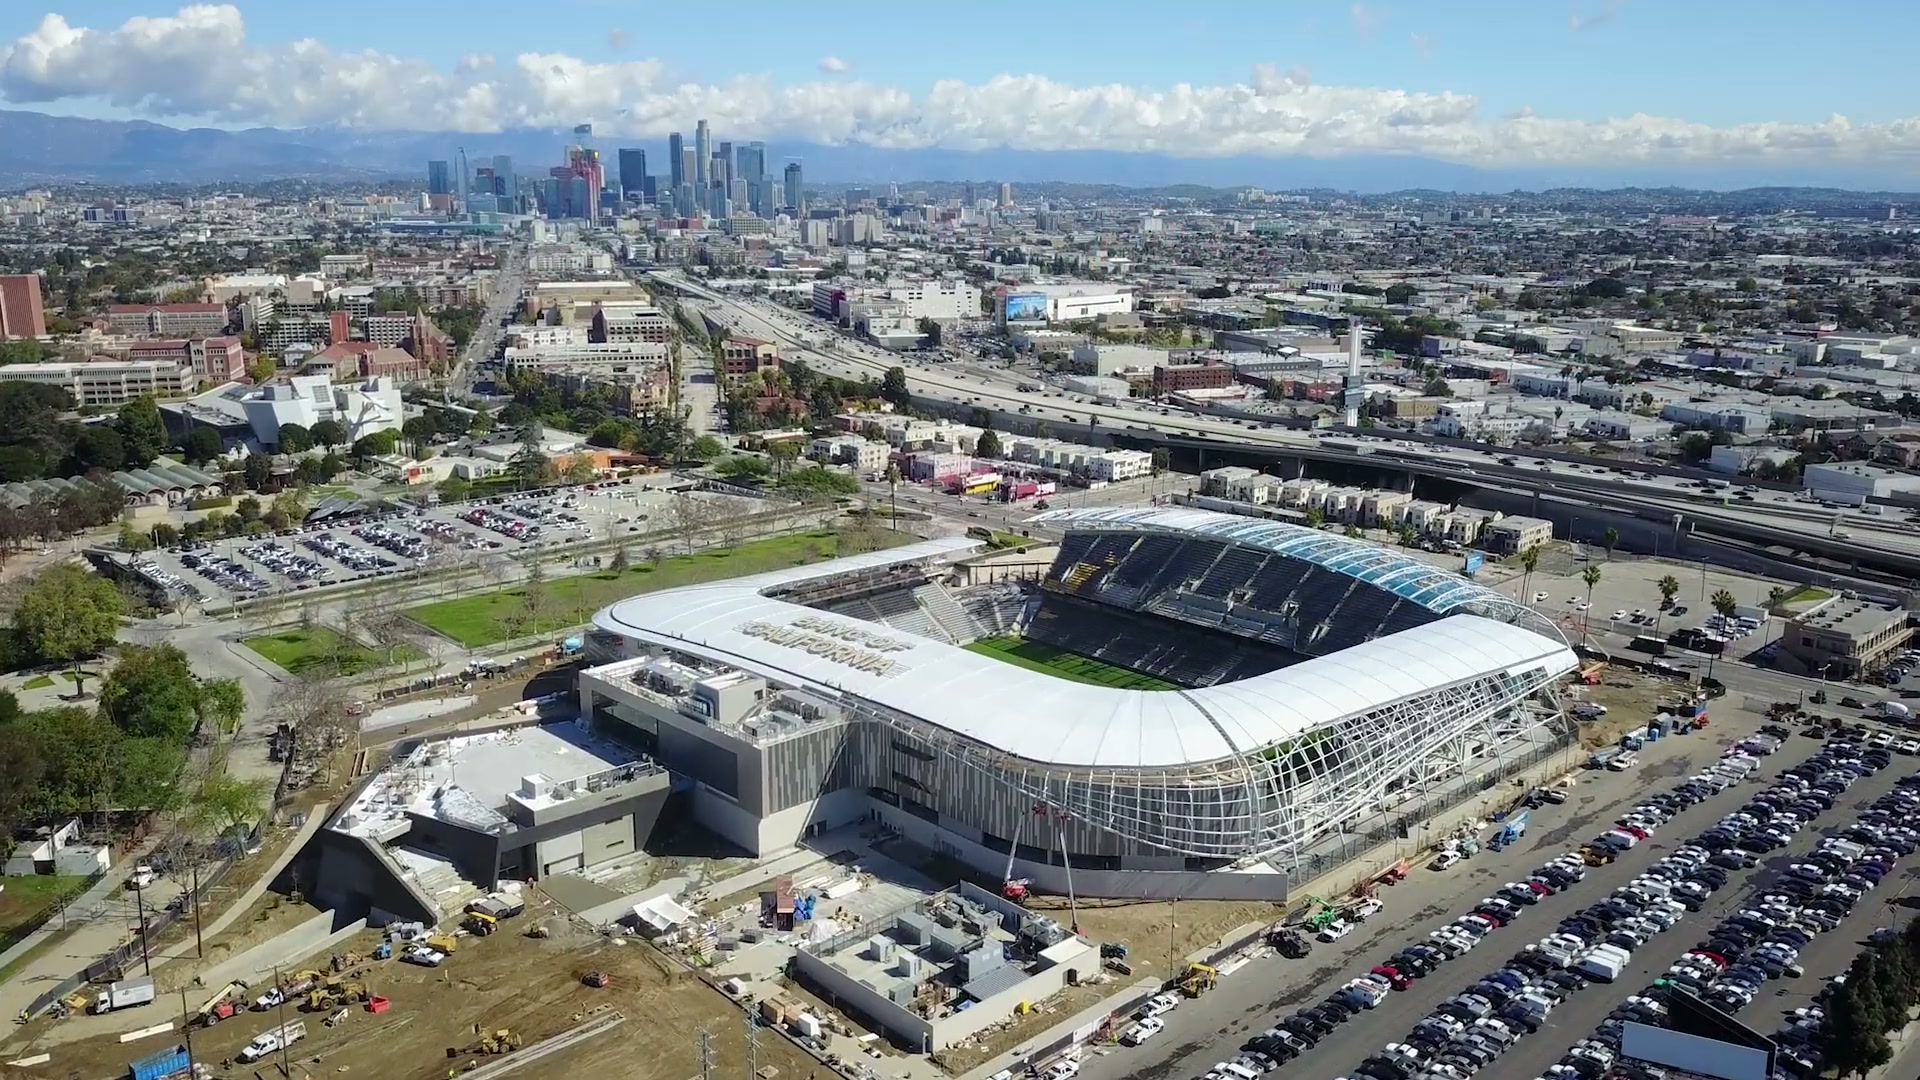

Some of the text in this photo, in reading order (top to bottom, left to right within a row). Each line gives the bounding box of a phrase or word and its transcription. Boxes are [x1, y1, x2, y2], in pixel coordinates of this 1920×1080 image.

[742, 622, 897, 677] CALIFORNIA
[790, 616, 916, 653] BANC OF
